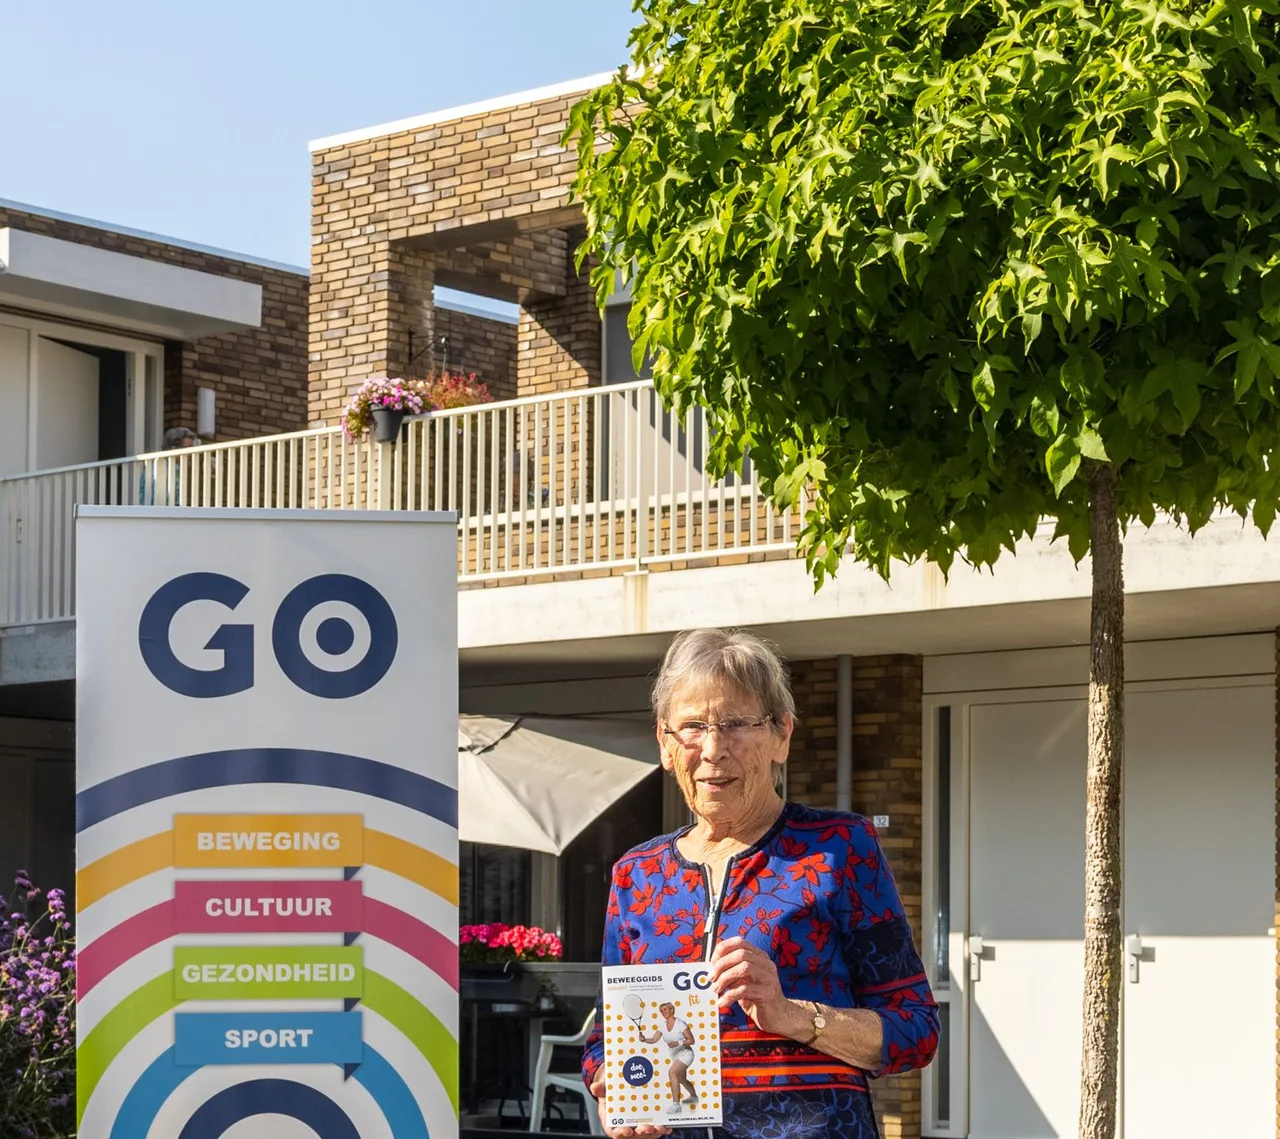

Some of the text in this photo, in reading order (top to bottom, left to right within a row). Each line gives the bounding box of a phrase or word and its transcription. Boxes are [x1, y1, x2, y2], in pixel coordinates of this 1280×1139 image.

[138, 571, 399, 699] GO
[875, 816, 887, 826] 32
[197, 832, 341, 851] BEWEGING
[205, 897, 333, 917] CULTUUR
[182, 963, 356, 983] GEZONDHEID
[607, 975, 663, 984] BEWEEGGIDS
[673, 971, 712, 991] GO
[688, 994, 700, 1007] fit
[224, 1029, 314, 1049] SPORT
